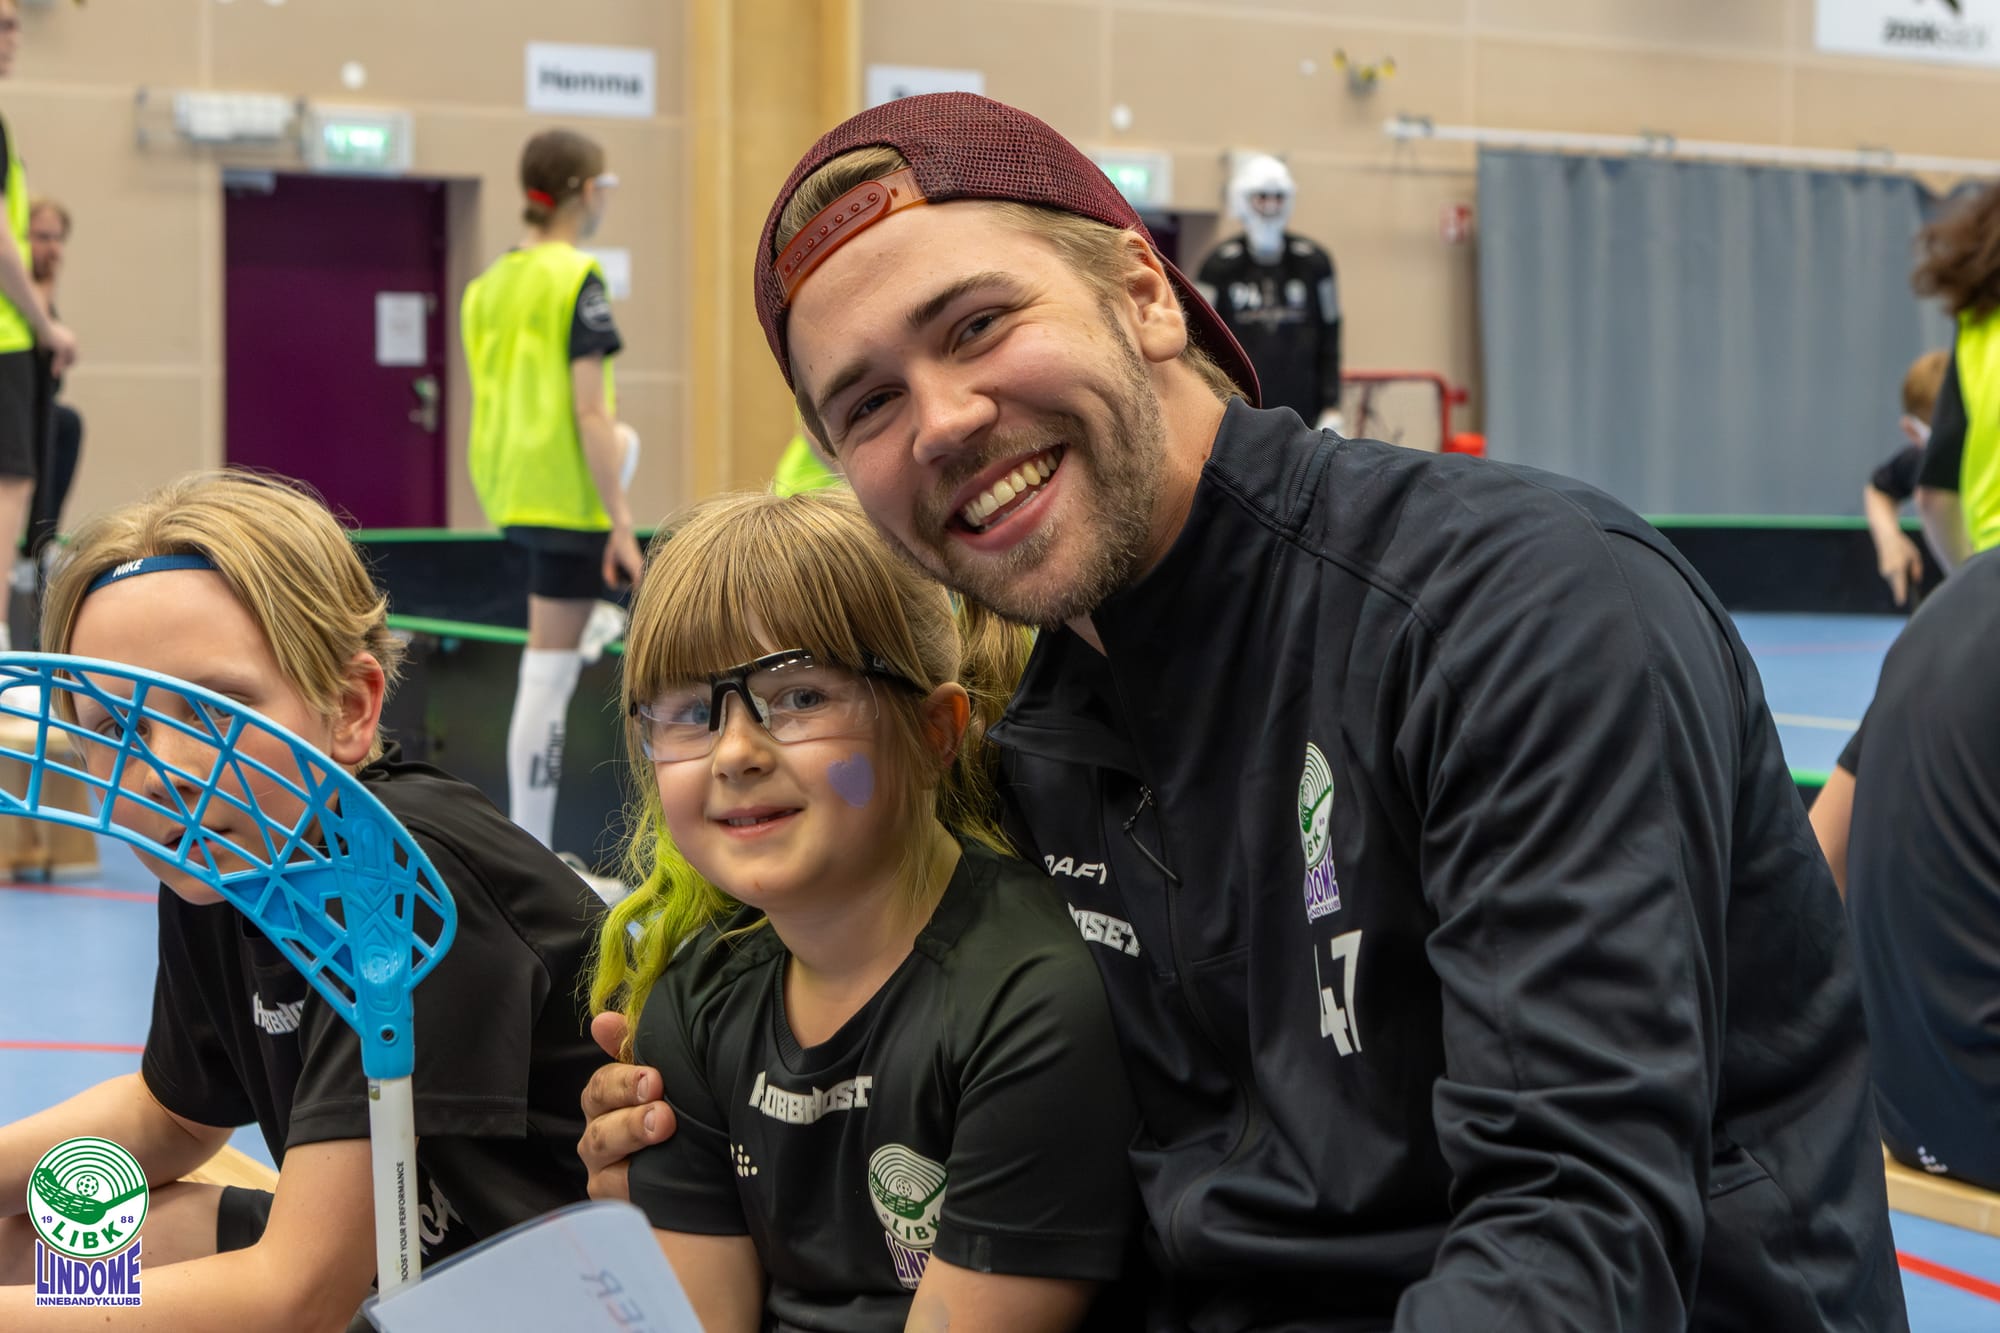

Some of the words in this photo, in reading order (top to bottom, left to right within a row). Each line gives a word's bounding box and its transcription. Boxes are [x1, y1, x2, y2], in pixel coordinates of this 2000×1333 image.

[112, 558, 143, 578] NIKE
[396, 1161, 407, 1226] PERFORMANCE
[399, 1227, 408, 1252] YOUR
